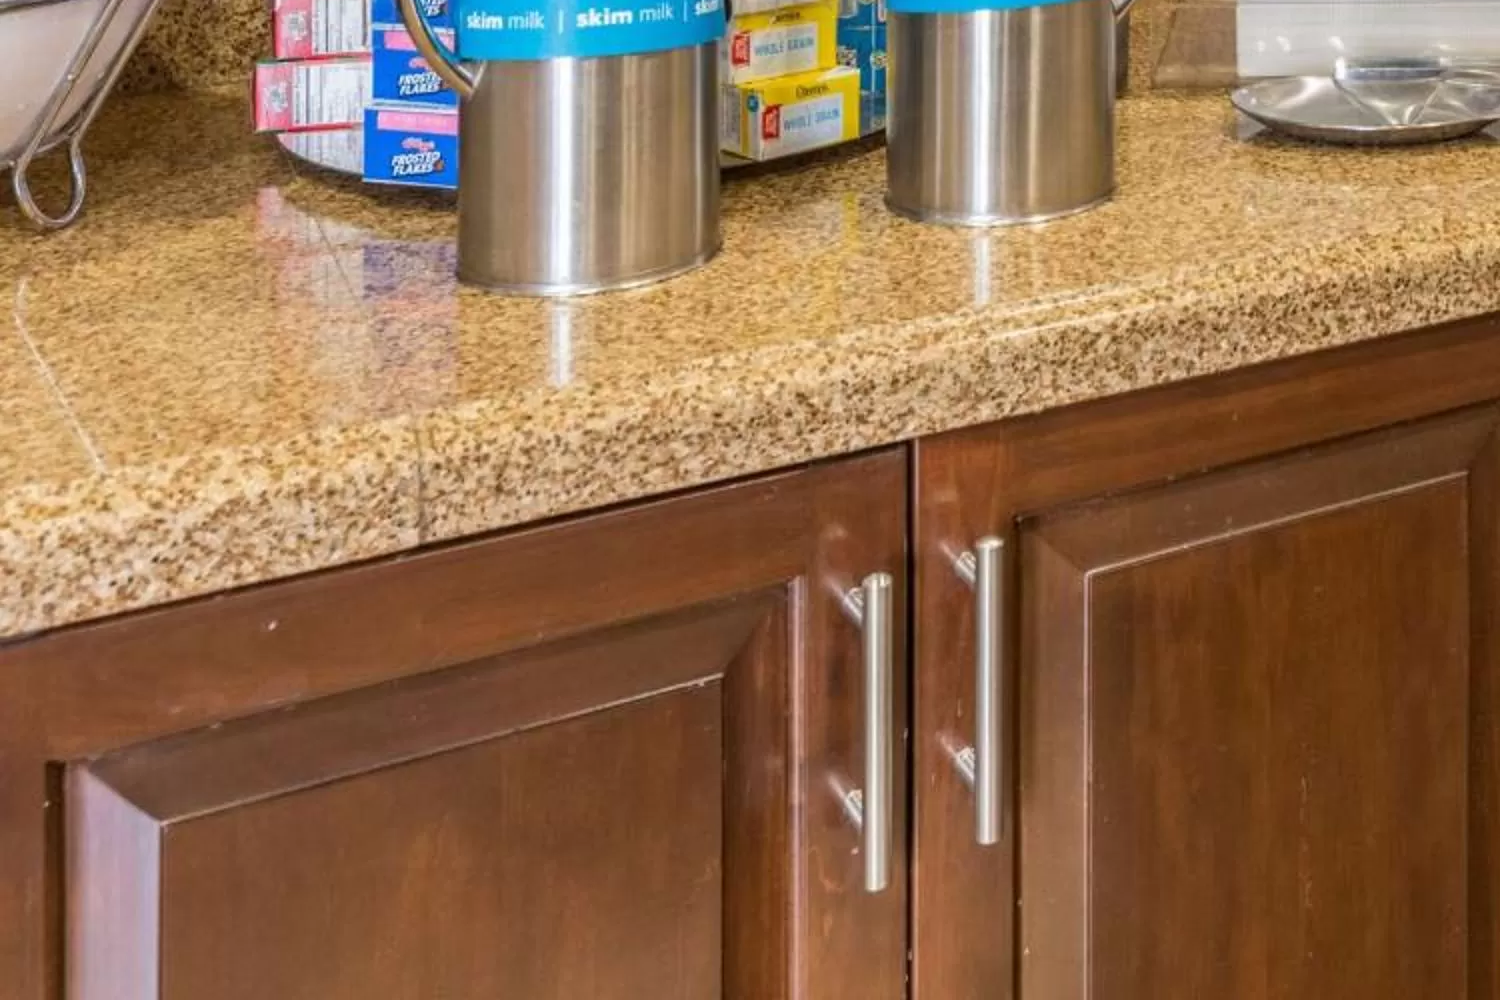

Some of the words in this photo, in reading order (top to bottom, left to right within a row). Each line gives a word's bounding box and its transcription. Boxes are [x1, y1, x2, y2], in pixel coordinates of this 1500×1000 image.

[467, 11, 503, 29] skim
[508, 12, 544, 30] milk
[576, 8, 633, 29] skim
[640, 3, 674, 22] milk
[399, 81, 440, 95] FLAKES
[391, 151, 441, 169] FROSTED
[393, 162, 433, 177] FLAKES
